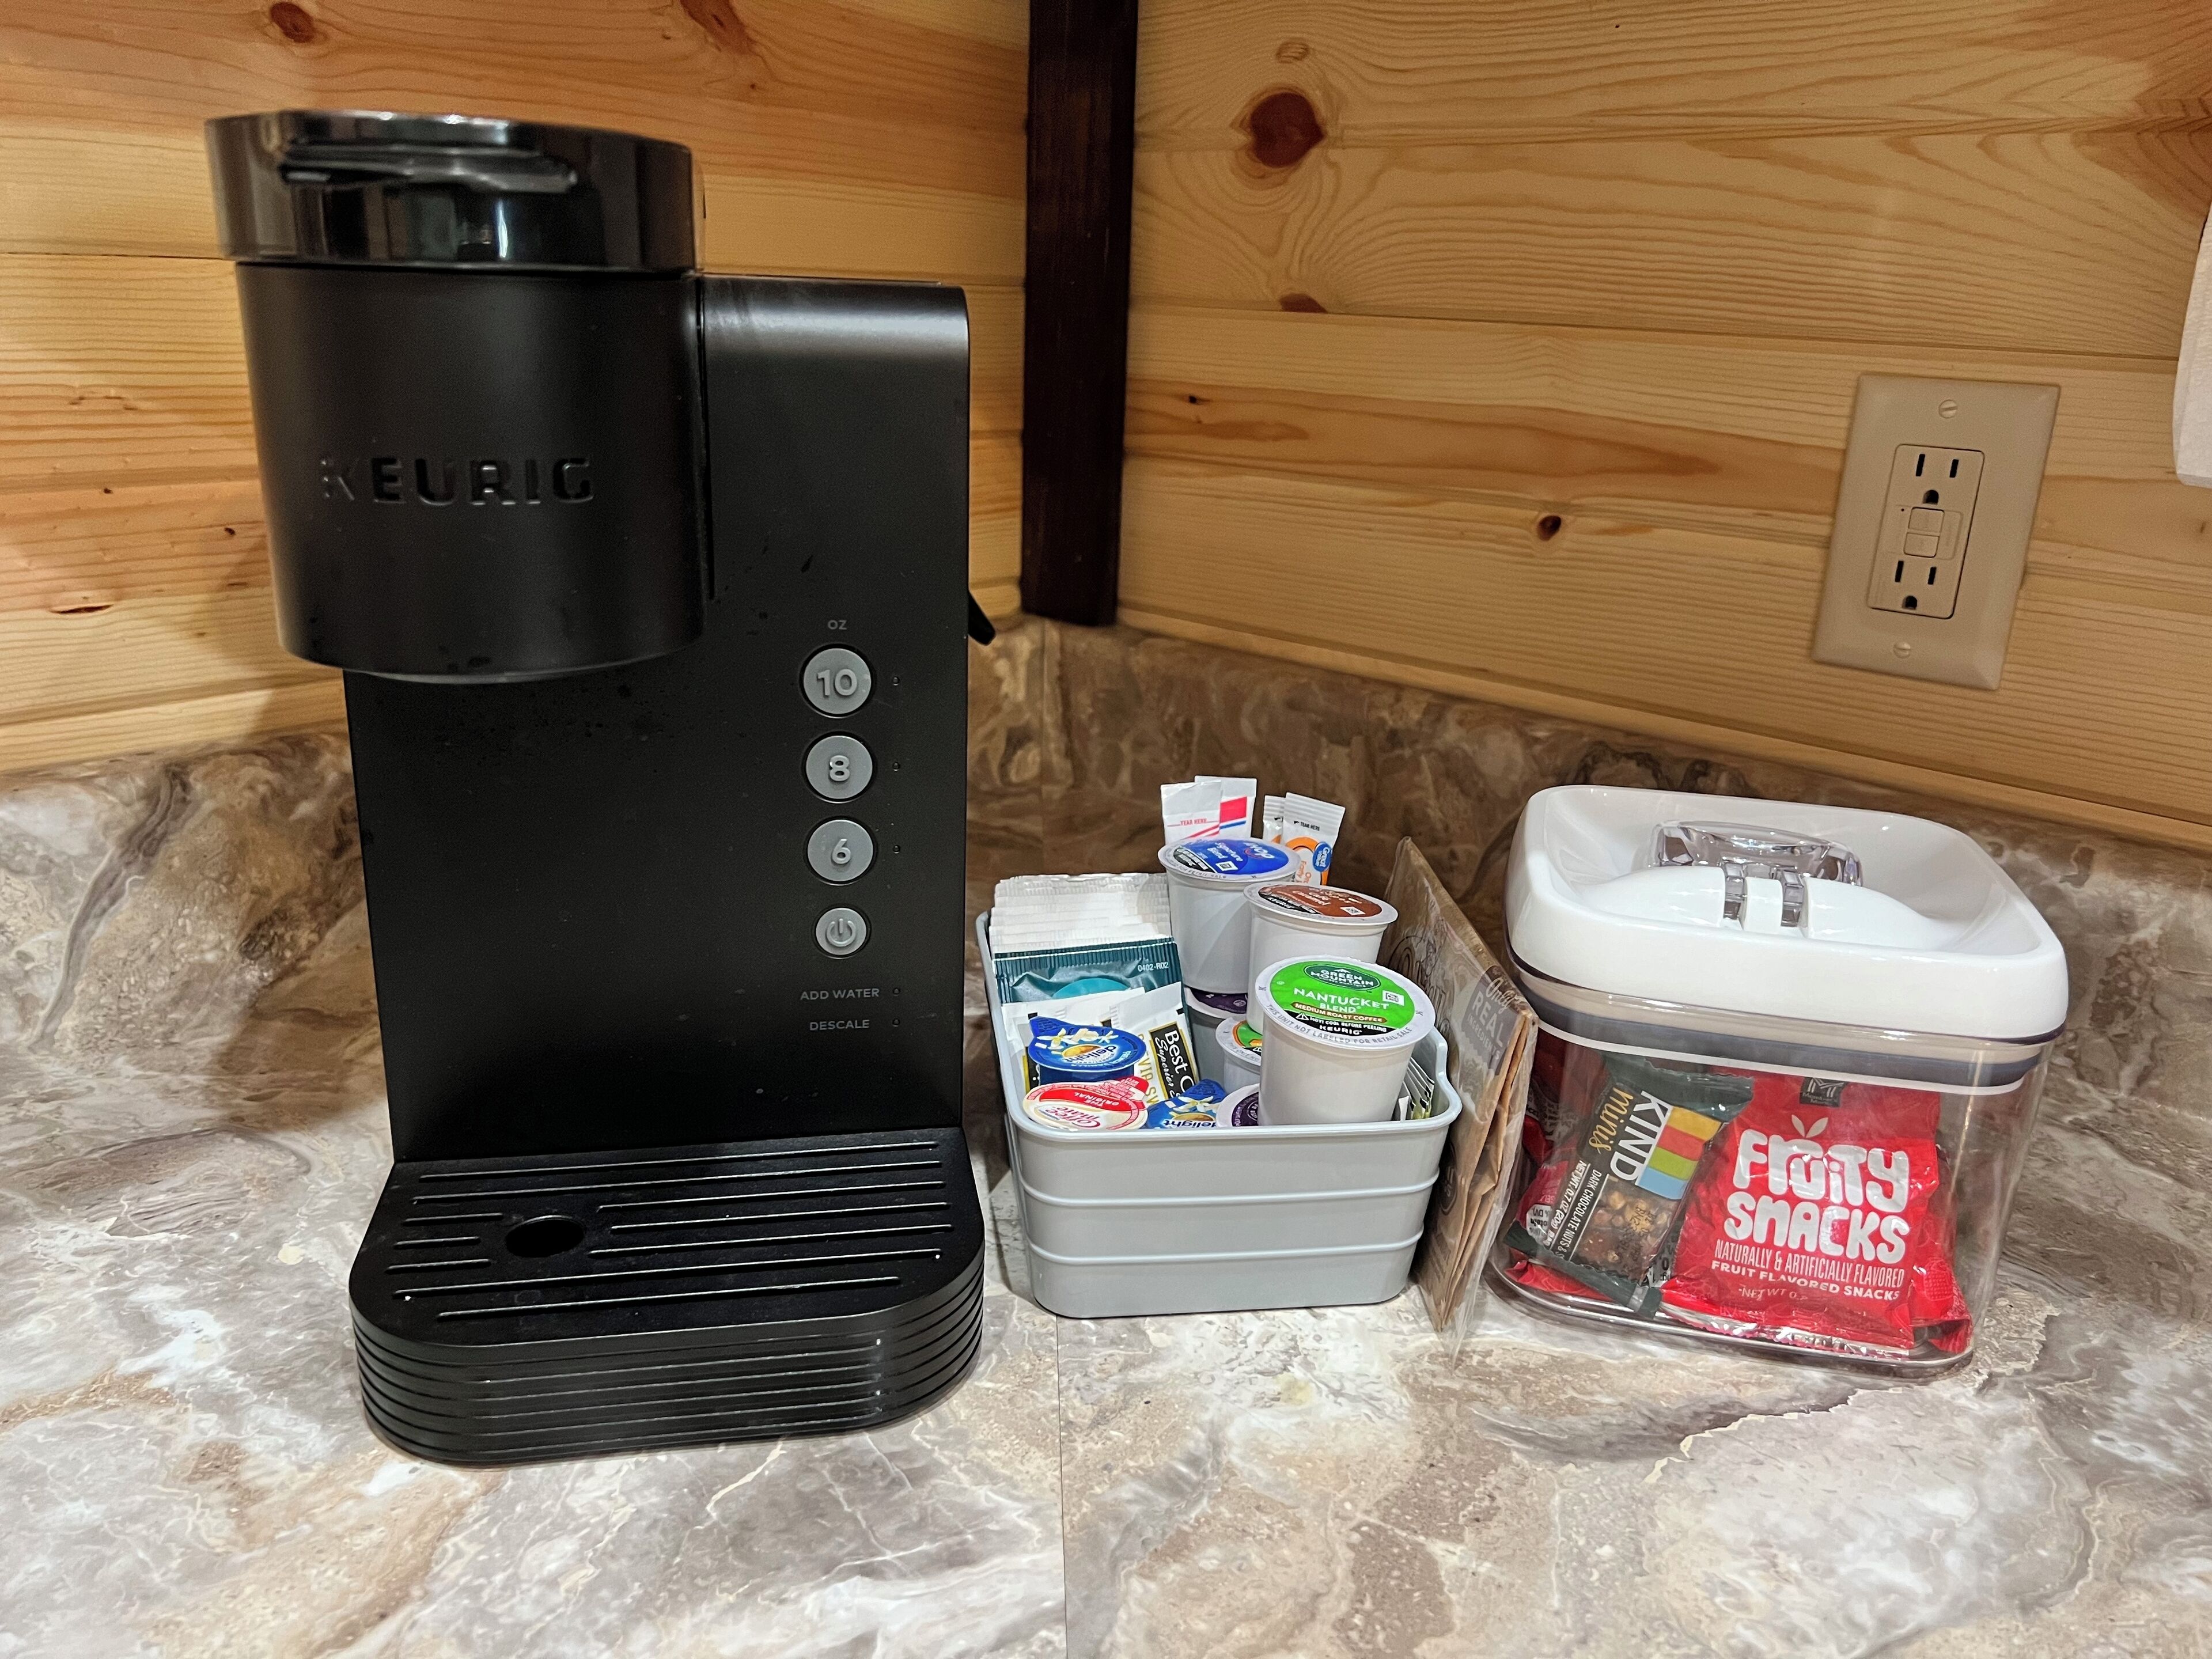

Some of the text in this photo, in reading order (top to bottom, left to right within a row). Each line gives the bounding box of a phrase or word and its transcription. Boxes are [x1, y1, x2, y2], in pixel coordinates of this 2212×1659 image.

[827, 620, 847, 630] OZ
[816, 668, 858, 696] 10
[830, 755, 850, 782] 8
[831, 838, 851, 864] 6
[1310, 971, 1374, 986] MOUNTAIN
[1321, 969, 1362, 980] GREEN
[800, 988, 880, 1000] ADD WATER
[1294, 987, 1389, 1010] NANTUCKET
[1486, 977, 1516, 1014] Only
[1295, 1003, 1382, 1022] MEDIUM ROAST COFFEE
[1319, 1002, 1357, 1013] BLEND
[1472, 991, 1503, 1047] REAL
[809, 1020, 870, 1031] DESCALE
[1267, 1004, 1278, 1015] THIS
[1278, 1014, 1294, 1026] UNIT
[1294, 1025, 1310, 1033] NOT
[1313, 1031, 1350, 1044] LABELED
[1372, 1035, 1396, 1043] RETAIL
[1396, 1027, 1412, 1037] SALE
[1319, 1025, 1360, 1035] KEURIG
[1468, 1013, 1500, 1060] INGREDIENTS
[1064, 1046, 1117, 1063] delight
[1155, 1037, 1174, 1086] Superior
[1165, 1030, 1188, 1074] Best
[1074, 1092, 1120, 1107] ORIGINAL
[1083, 1099, 1104, 1107] THE
[1046, 1109, 1101, 1128] Coffee
[1588, 1087, 1634, 1154] minis
[1610, 1090, 1672, 1185] KIND
[1576, 1160, 1588, 1175] NET
[1587, 1169, 1602, 1194] DARK
[1567, 1190, 1594, 1231] CHOCOLATE
[1560, 1229, 1575, 1248] NUTS
[1714, 1240, 1905, 1288] NATURALLY & ARTIFICIALLY FLAVORED
[1711, 1261, 1900, 1301] FRUIT FLAVORED SNACKS
[1767, 1288, 1787, 1296] WT
